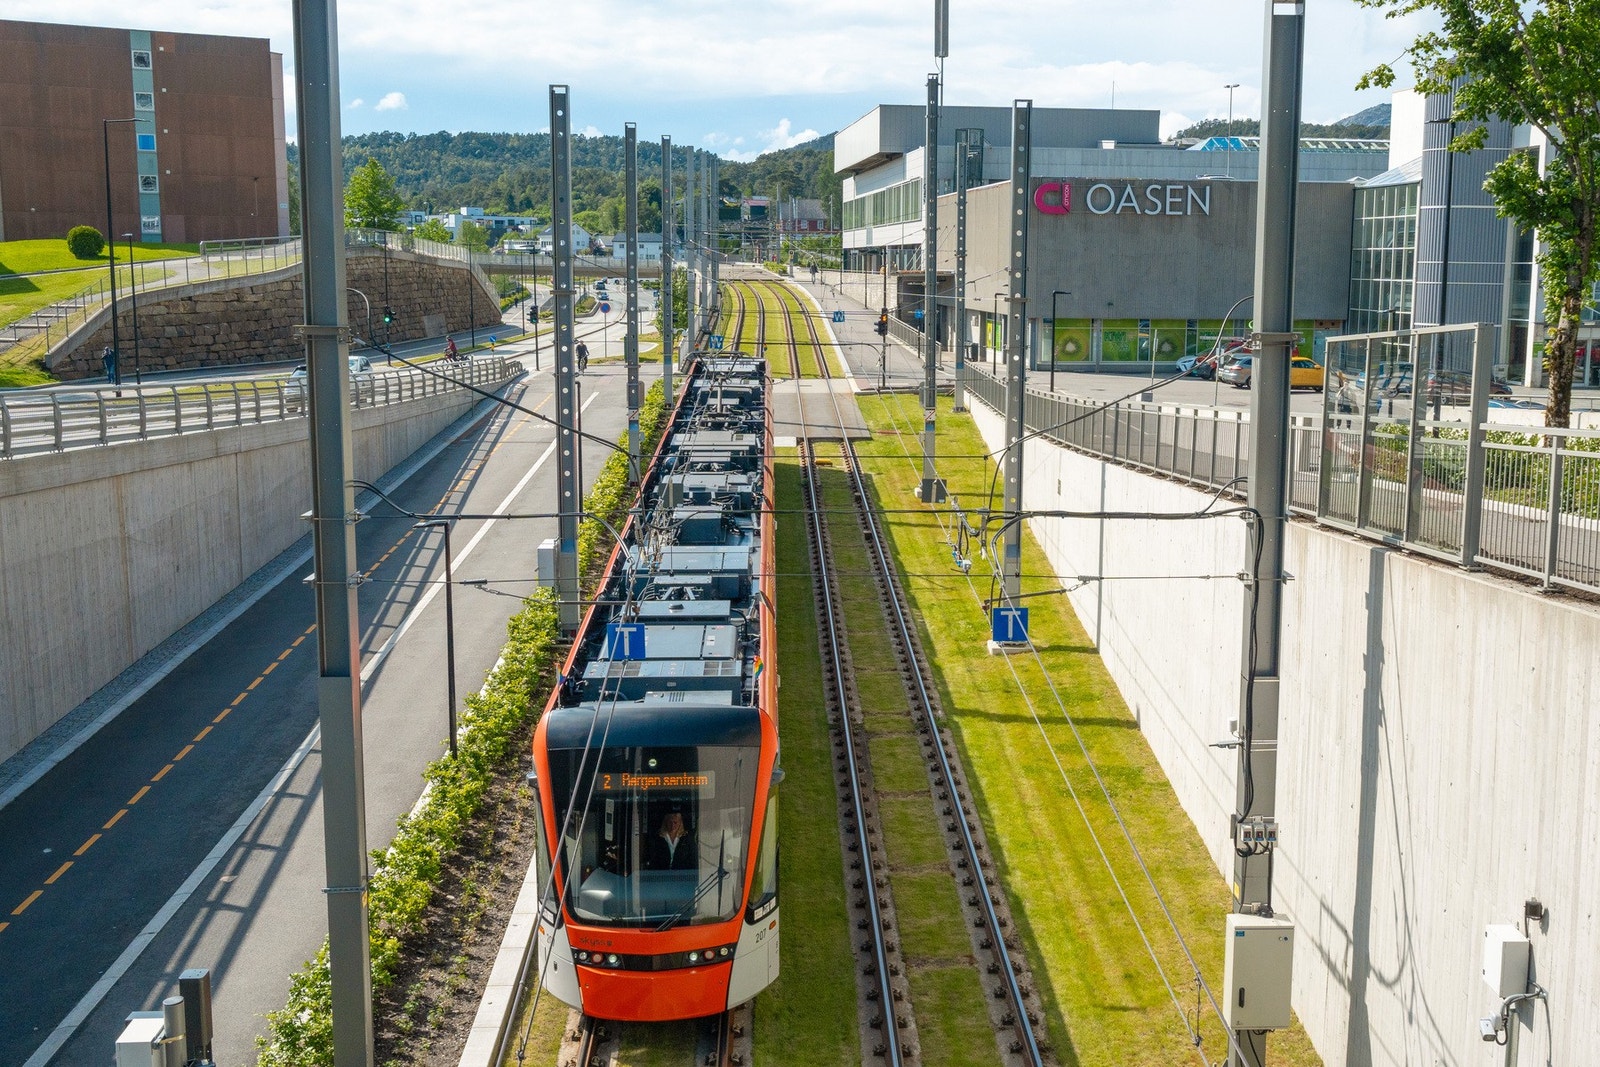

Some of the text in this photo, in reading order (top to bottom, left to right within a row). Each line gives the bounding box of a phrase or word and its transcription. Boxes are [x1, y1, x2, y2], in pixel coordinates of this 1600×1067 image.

[1086, 183, 1211, 216] OASEN
[1000, 610, 1021, 640] T
[615, 627, 637, 656] T
[603, 774, 611, 790] 2
[755, 928, 766, 943] 207
